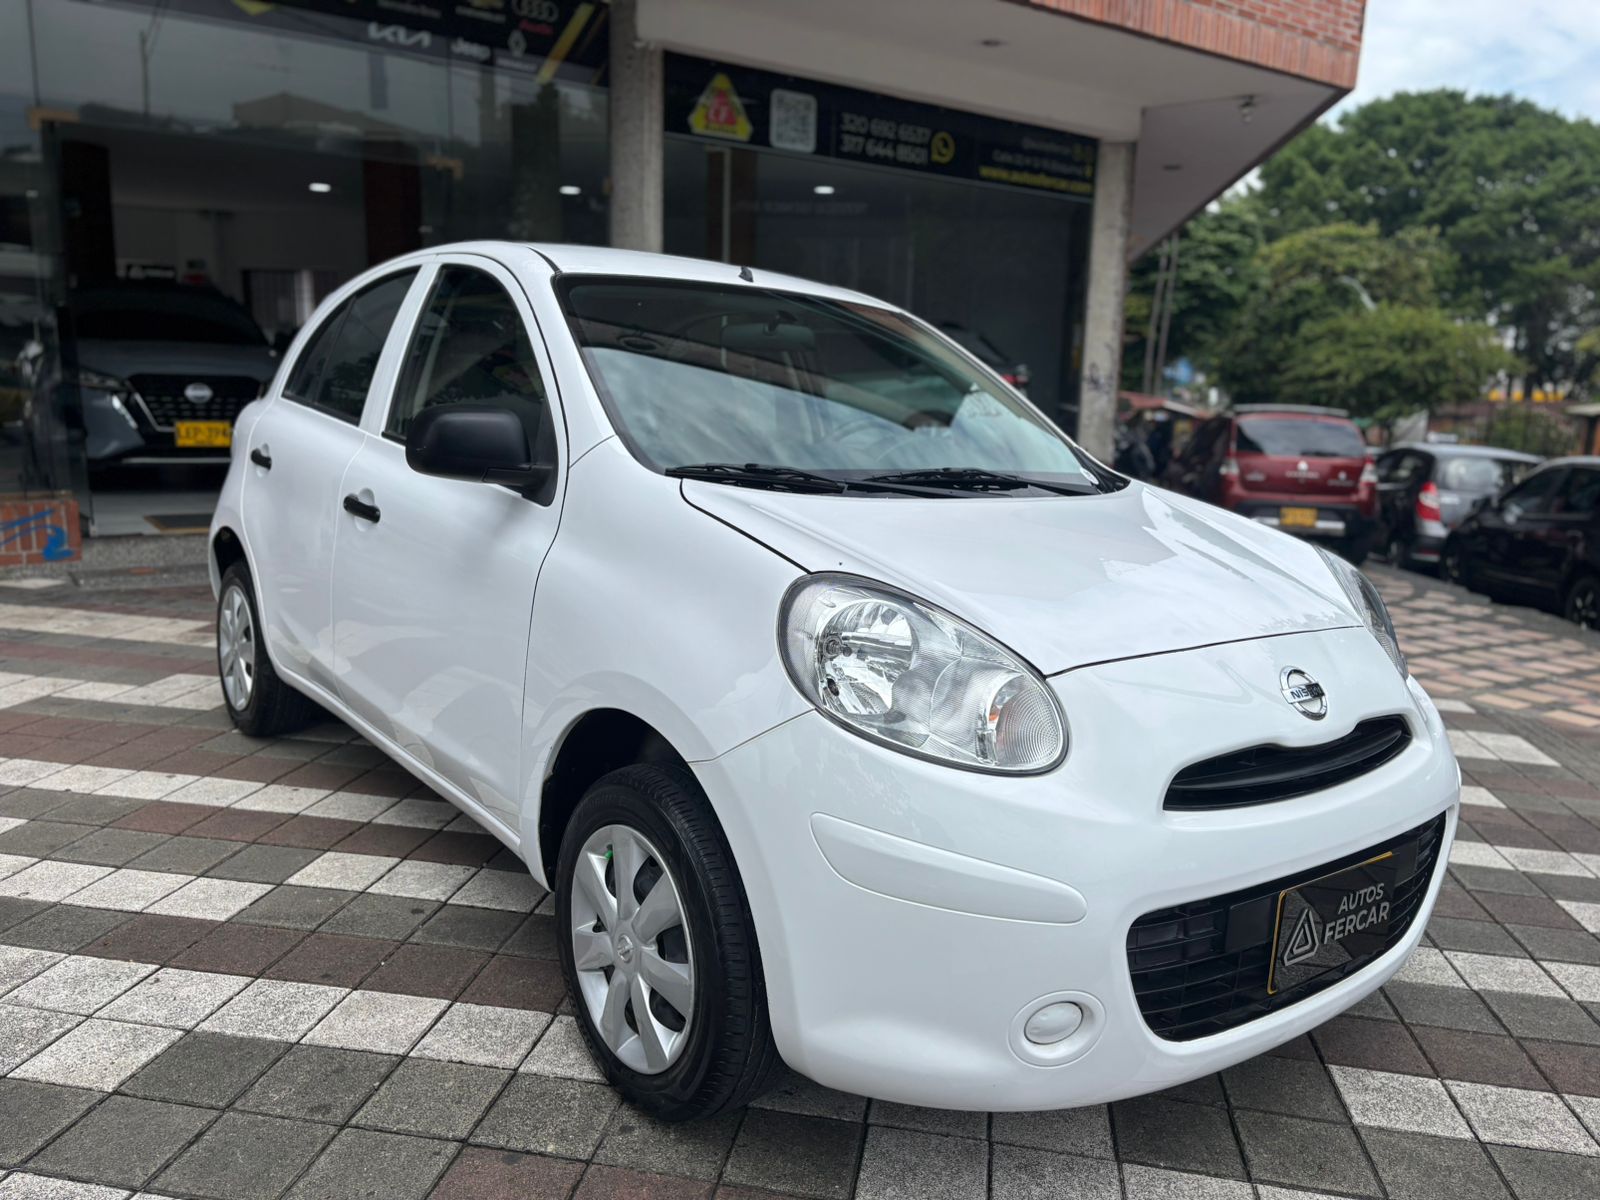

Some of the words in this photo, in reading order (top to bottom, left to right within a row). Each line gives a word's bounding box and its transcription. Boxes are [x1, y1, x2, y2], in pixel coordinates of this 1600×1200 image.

[840, 112, 868, 133] 320
[840, 135, 865, 155] 317
[1338, 883, 1384, 915] AUTOS
[1323, 901, 1390, 944] FERCAR
